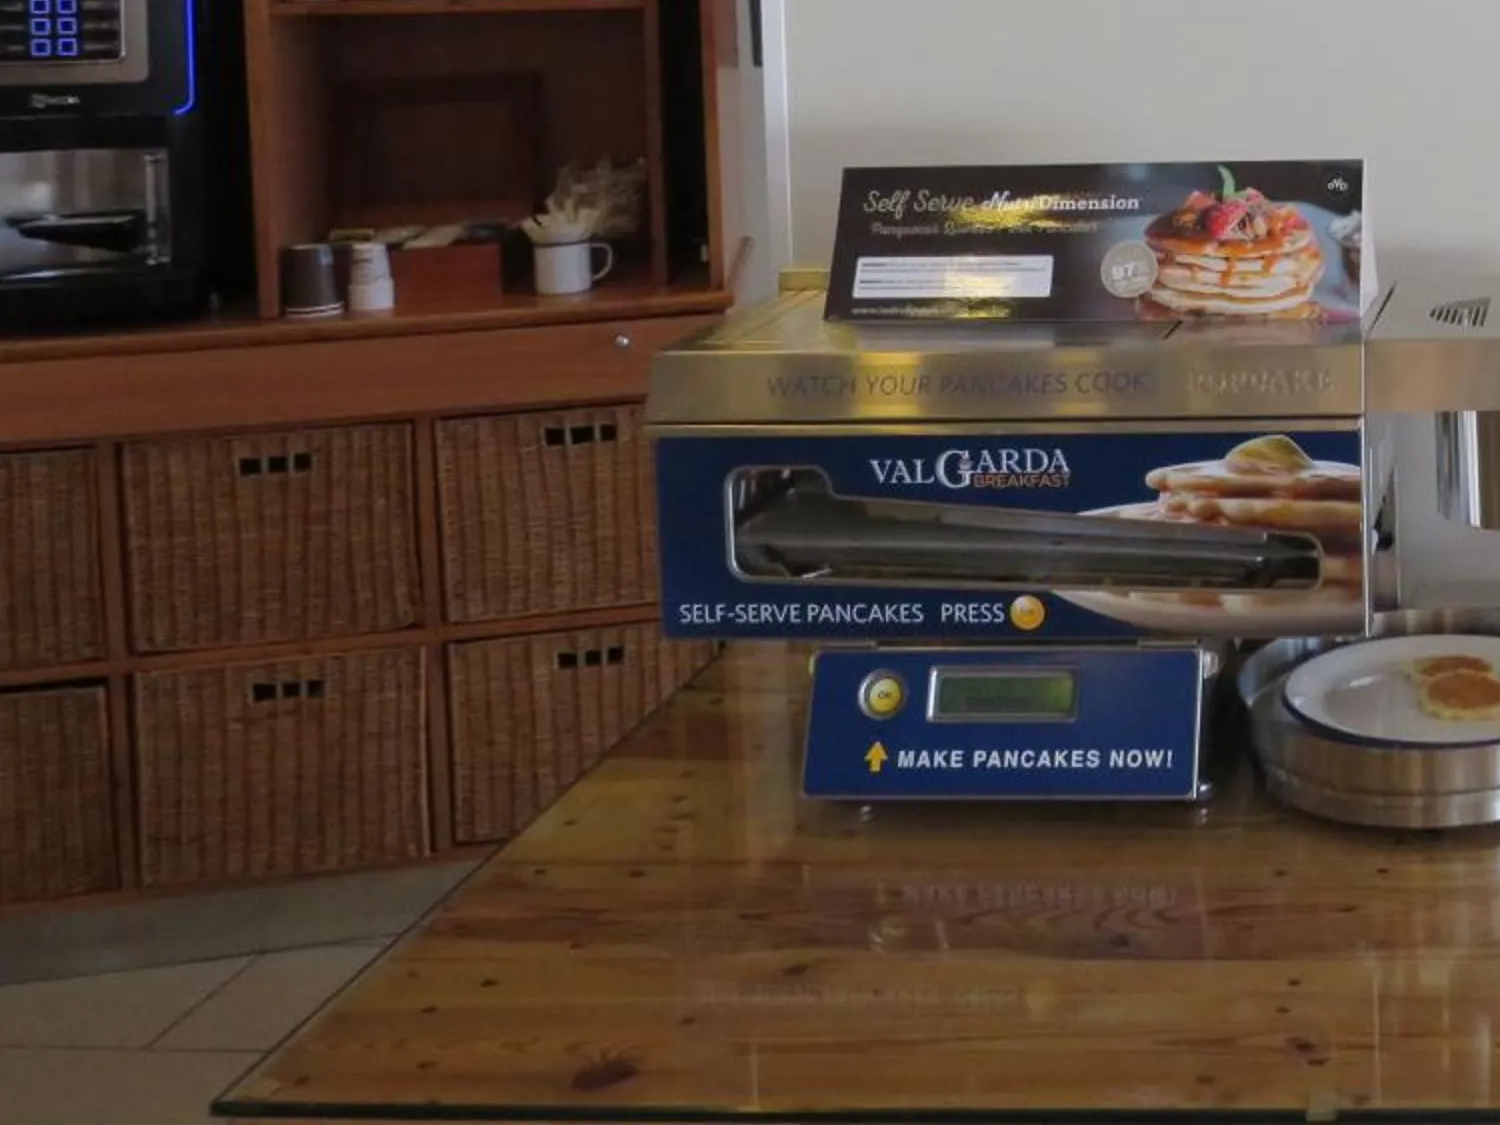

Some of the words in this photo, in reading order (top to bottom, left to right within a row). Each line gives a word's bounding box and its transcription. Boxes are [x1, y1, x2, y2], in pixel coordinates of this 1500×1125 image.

[863, 189, 910, 220] Self
[913, 189, 974, 212] Serve
[863, 375, 929, 396] YOUR
[973, 474, 1070, 488] BREAKFAST
[679, 603, 801, 624] SELF-SERVE
[807, 603, 924, 623] PANCAKES
[941, 603, 1005, 623] PRESS
[897, 749, 964, 768] MAKE
[973, 749, 1101, 768] PANCAKES
[1109, 748, 1174, 768] NOW!
